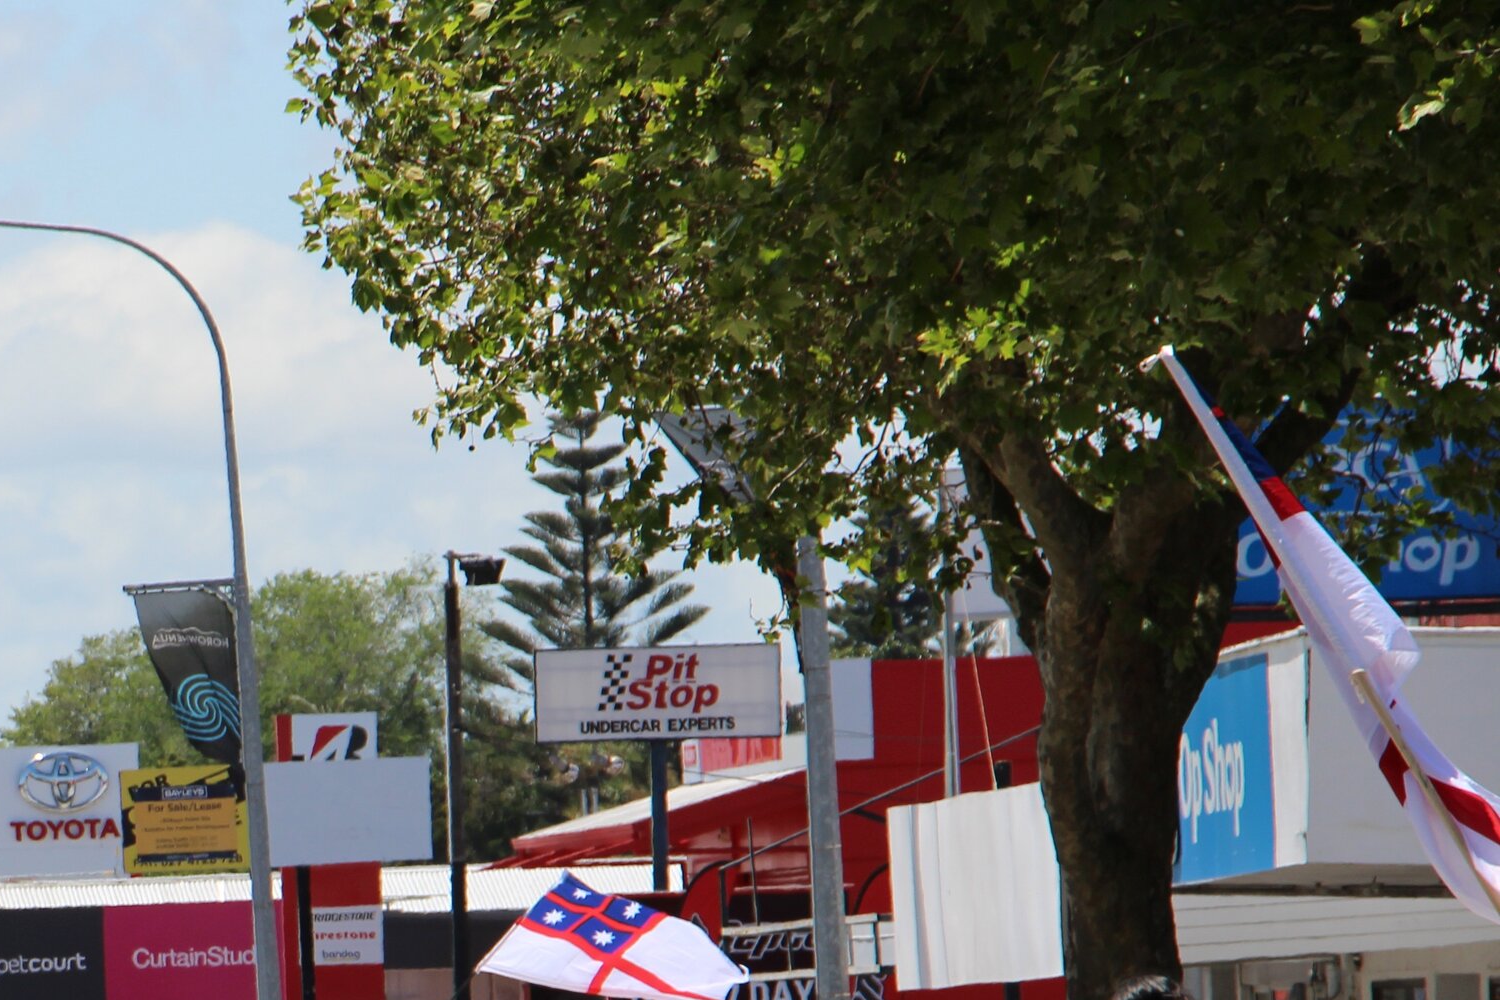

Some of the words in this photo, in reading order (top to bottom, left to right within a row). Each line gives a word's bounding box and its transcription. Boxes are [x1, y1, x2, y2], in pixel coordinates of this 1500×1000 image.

[646, 653, 699, 681] Pit
[626, 677, 720, 713] Stop
[580, 718, 661, 734] UNDERCAR
[668, 716, 735, 732] EXPERTS
[1178, 732, 1202, 844] Op
[1202, 717, 1245, 837] Shop
[164, 788, 205, 798] BAYLEYS
[148, 803, 165, 812] For
[168, 801, 222, 813] Sale/Lease
[9, 818, 121, 842] TOYOTA
[313, 911, 377, 923] RIDGESTONE
[312, 930, 376, 940] irestone
